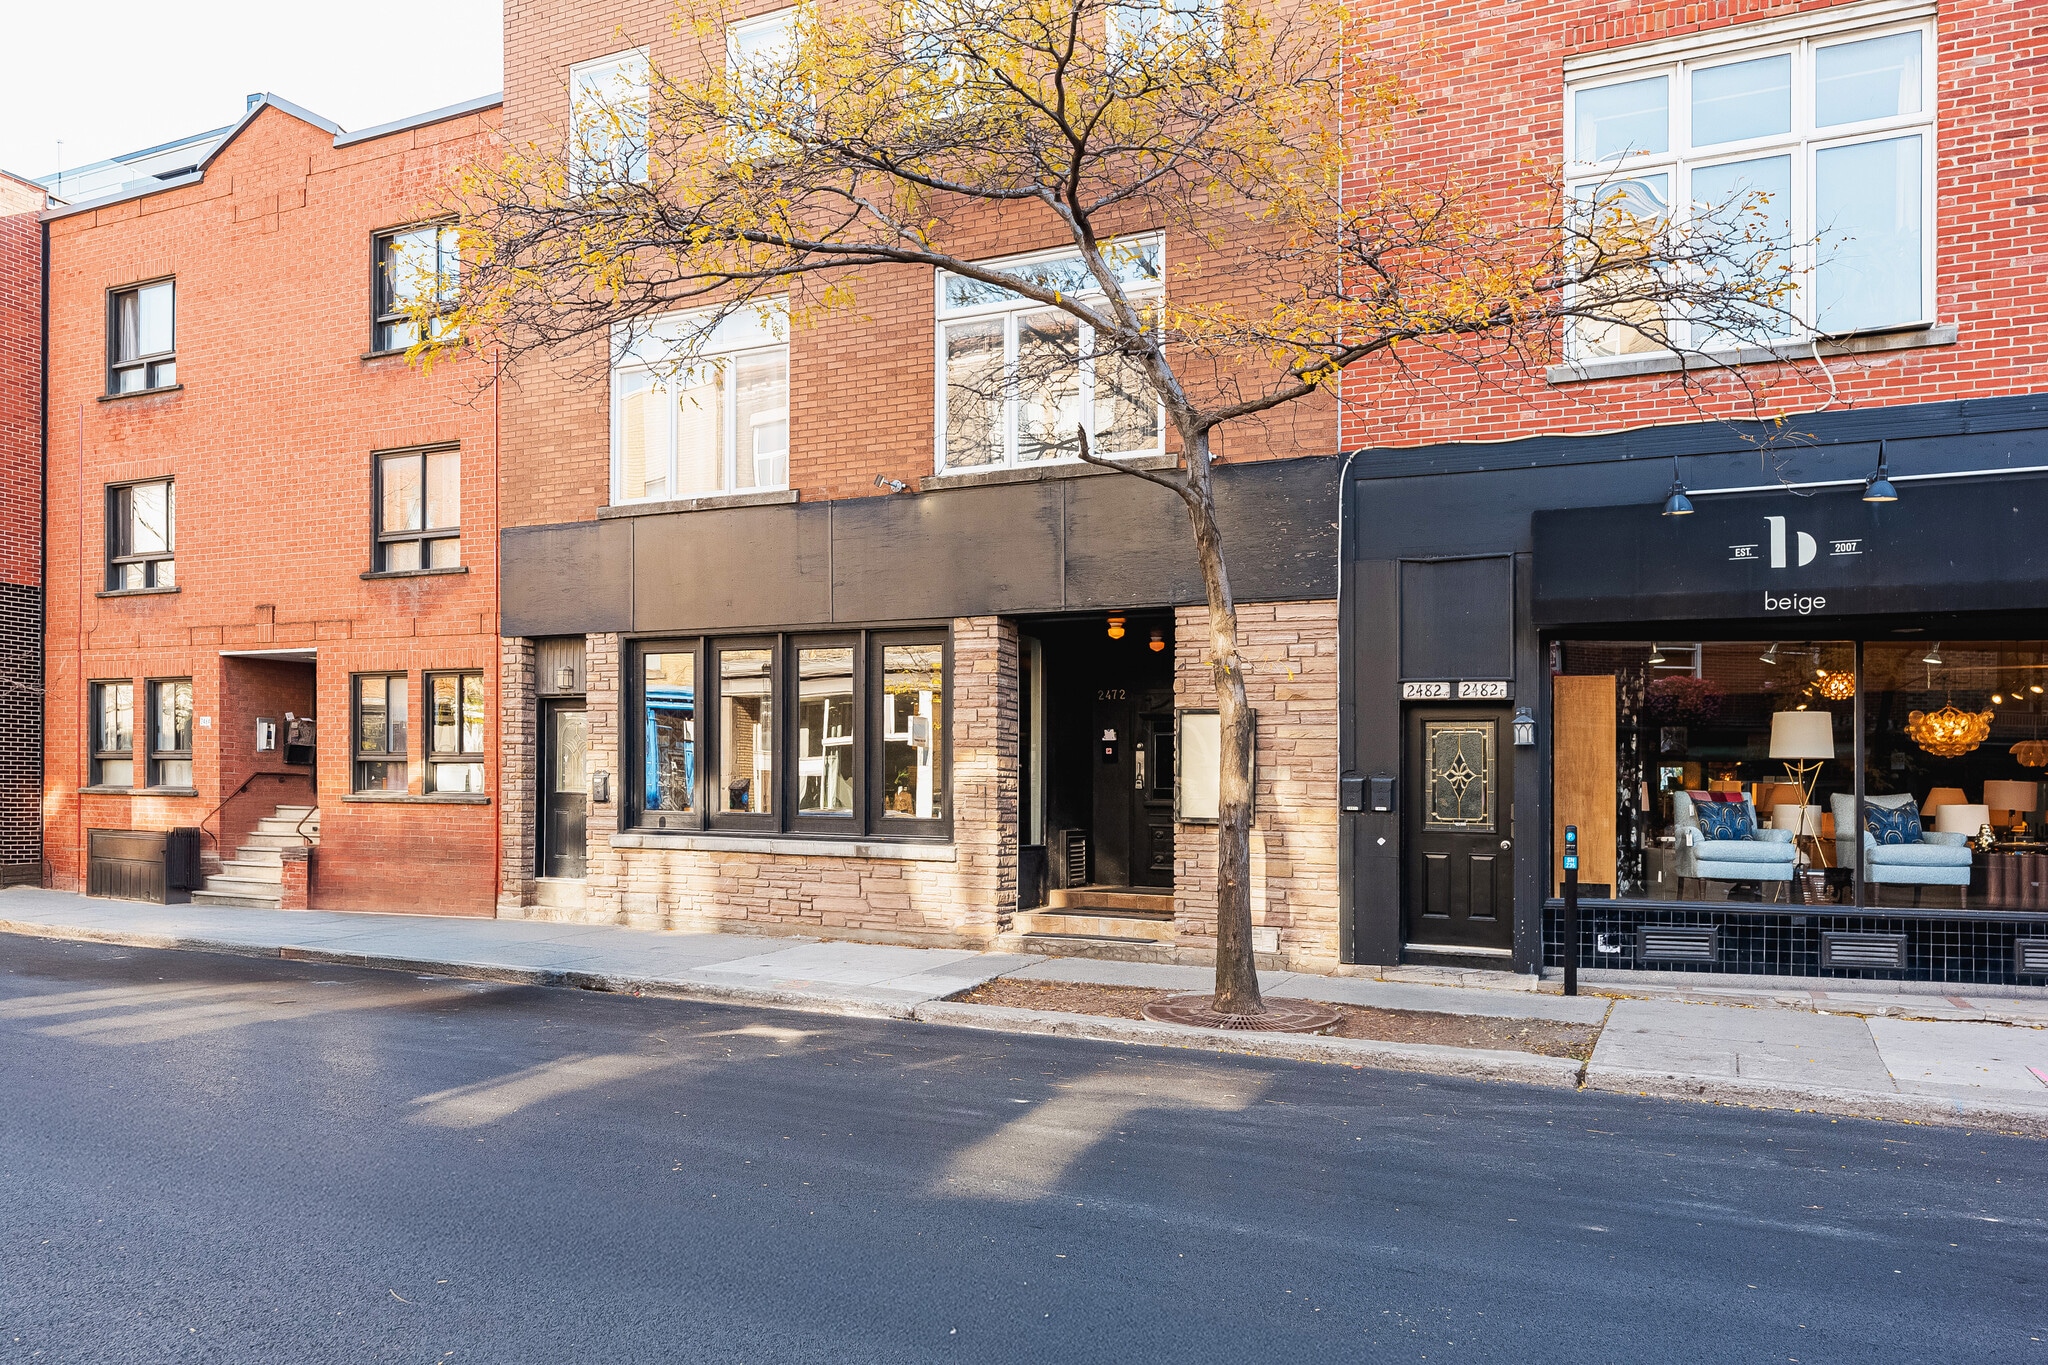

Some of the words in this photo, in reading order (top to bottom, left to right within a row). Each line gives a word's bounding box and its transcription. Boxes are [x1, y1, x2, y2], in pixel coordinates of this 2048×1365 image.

[1735, 548, 1752, 557] EST.
[1835, 543, 1857, 552] 2007
[1765, 591, 1826, 614] beige
[1098, 689, 1126, 700] 2472
